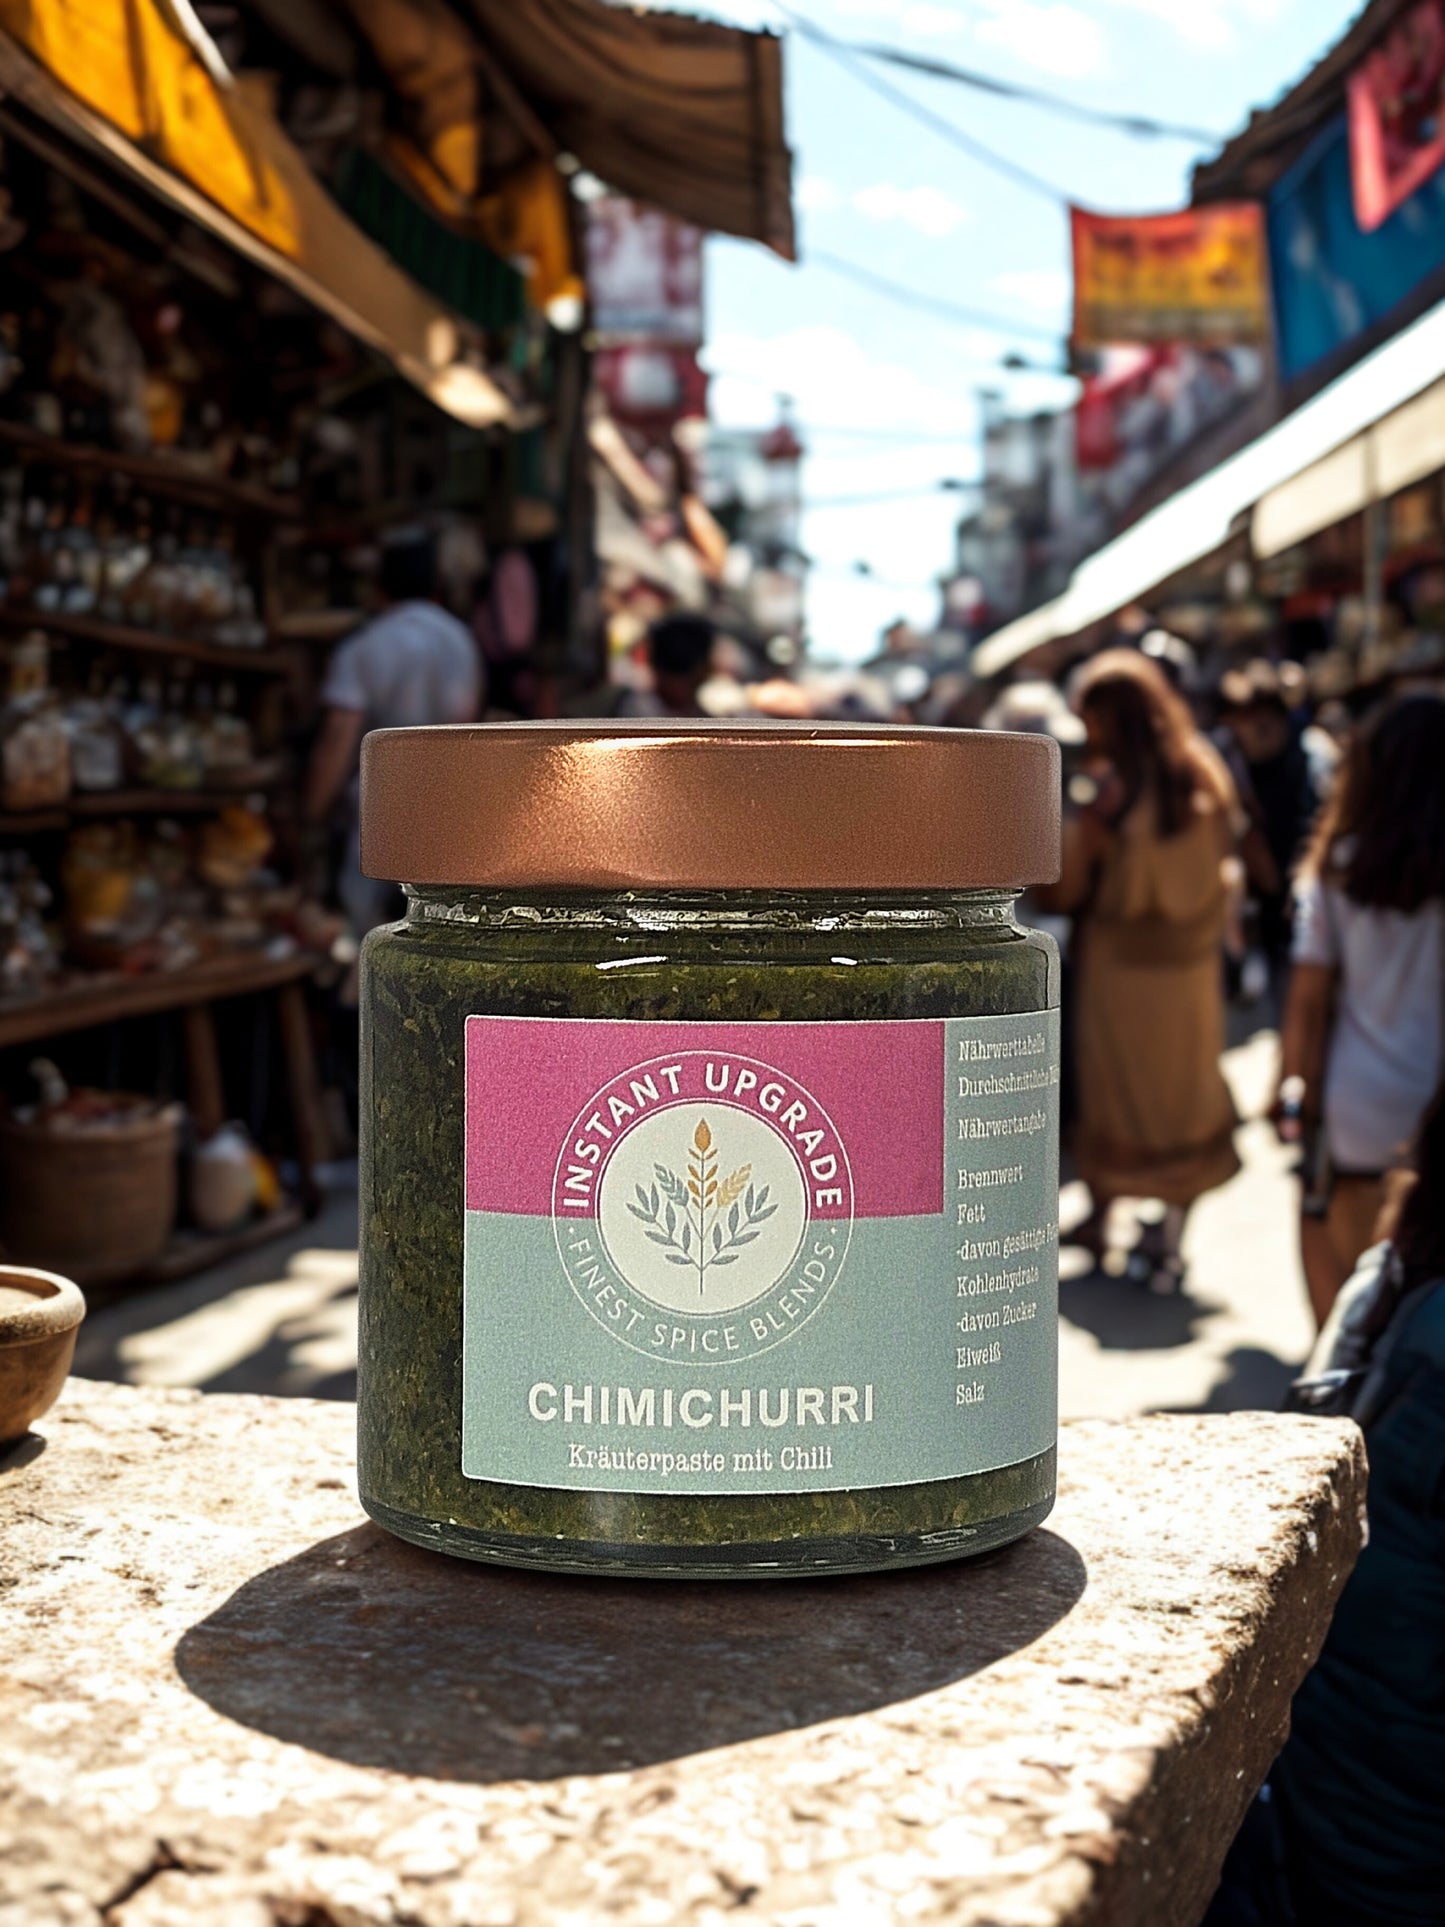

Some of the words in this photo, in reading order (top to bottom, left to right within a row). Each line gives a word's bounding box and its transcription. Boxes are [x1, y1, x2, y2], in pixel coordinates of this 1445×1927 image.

[563, 1064, 684, 1208] INSTANT
[705, 1062, 842, 1207] UPGRADE
[958, 1164, 1024, 1190] Brennwert
[957, 1203, 986, 1225] Fett
[568, 1237, 646, 1331] FINEST
[651, 1323, 740, 1353] SPICE
[750, 1243, 835, 1341] BLENDS
[956, 1266, 1040, 1297] Kohlenhydrate
[1002, 1300, 1038, 1326] Zucker
[956, 1341, 1001, 1369] Eiweiß
[528, 1382, 875, 1428] CHIMICHURRI
[956, 1380, 985, 1405] Salz
[568, 1442, 725, 1477] Kräuterpaste
[732, 1446, 773, 1473] mit
[780, 1446, 833, 1472] Chili
